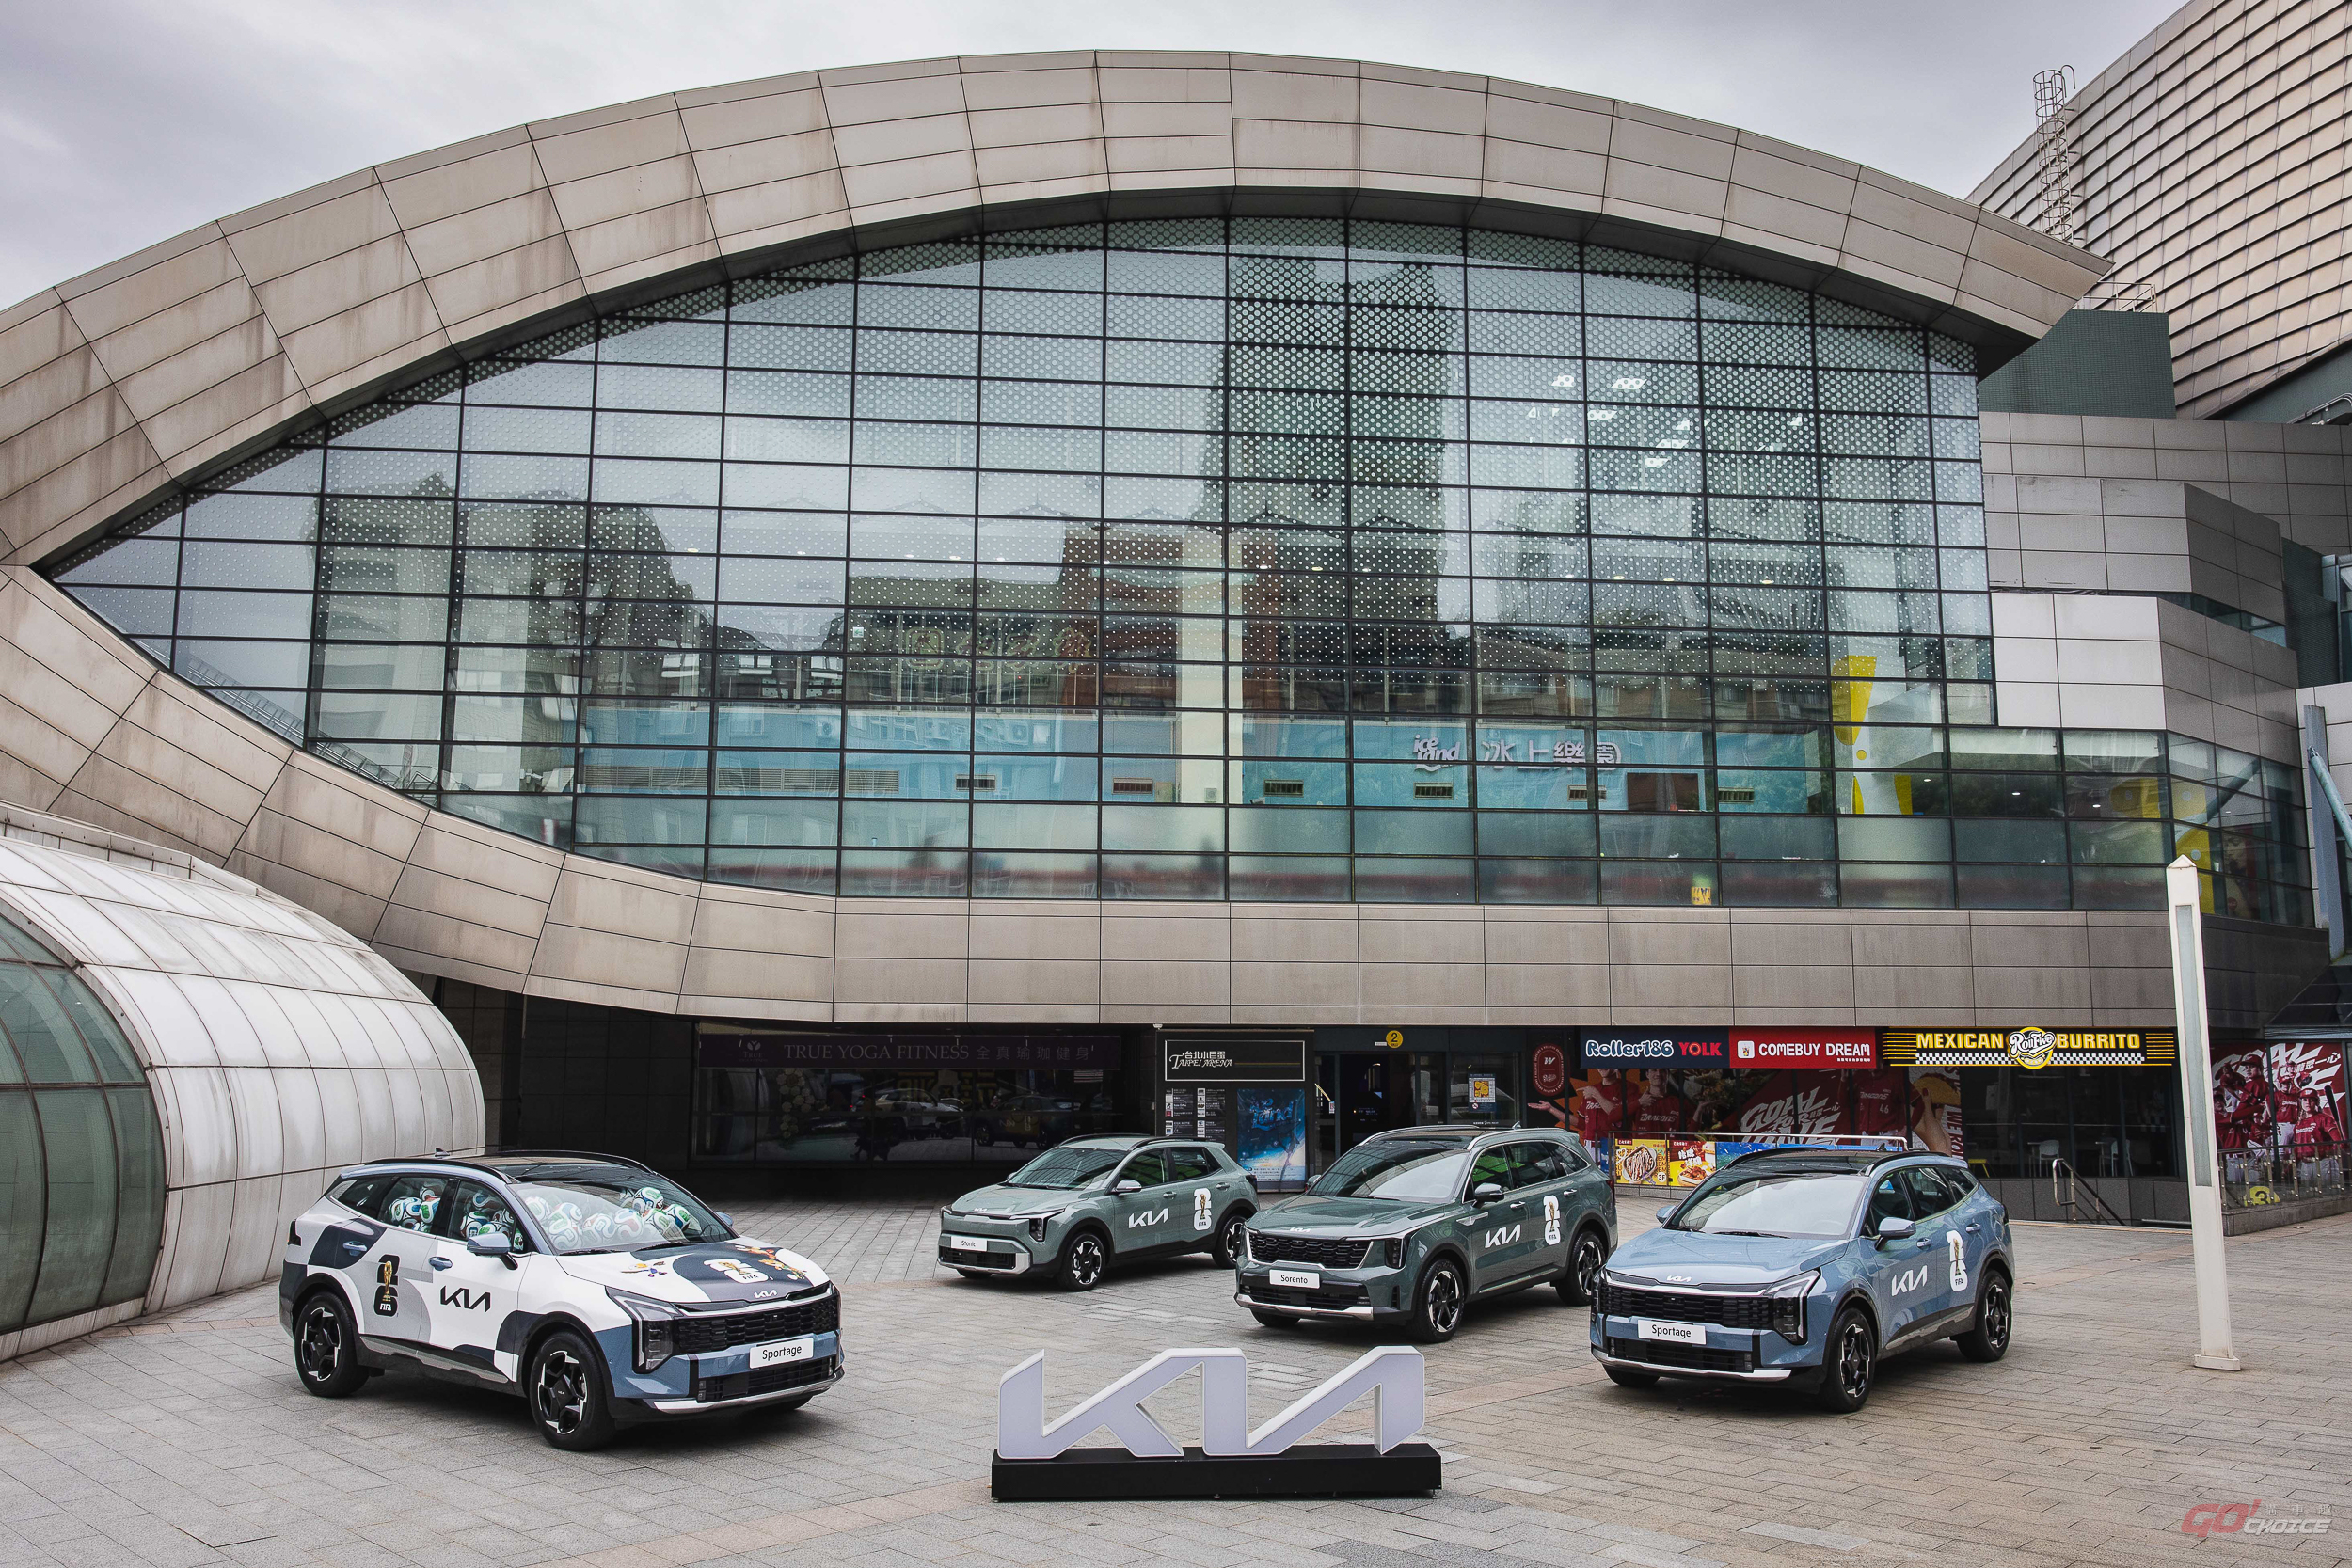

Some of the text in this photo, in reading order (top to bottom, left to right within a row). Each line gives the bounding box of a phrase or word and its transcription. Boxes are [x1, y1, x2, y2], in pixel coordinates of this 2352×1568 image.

[1413, 734, 1439, 753] ice
[1391, 1032, 1399, 1043] 2
[1915, 1033, 2005, 1049] MEXICAN
[2056, 1033, 2140, 1049] BURRITO
[784, 1044, 970, 1059] TRUE YOGA FITNESS
[976, 1045, 1090, 1060] 全真瑜珈健身
[1585, 1039, 1723, 1058] Roller186 YOLK
[1758, 1042, 1870, 1056] COMEBUY DREAM
[1201, 1058, 1232, 1068] ARENA
[1879, 1103, 1890, 1115] 46
[1128, 1208, 1169, 1229] KIA
[1484, 1224, 1522, 1249] KIA
[1280, 1274, 1309, 1284] Sorento
[1891, 1264, 1928, 1297] KIA
[379, 1302, 392, 1312] FIFA
[439, 1285, 491, 1313] KIA
[1651, 1323, 1692, 1339] Sportage
[762, 1345, 803, 1362] Sportage
[997, 1345, 1425, 1460] KIA
